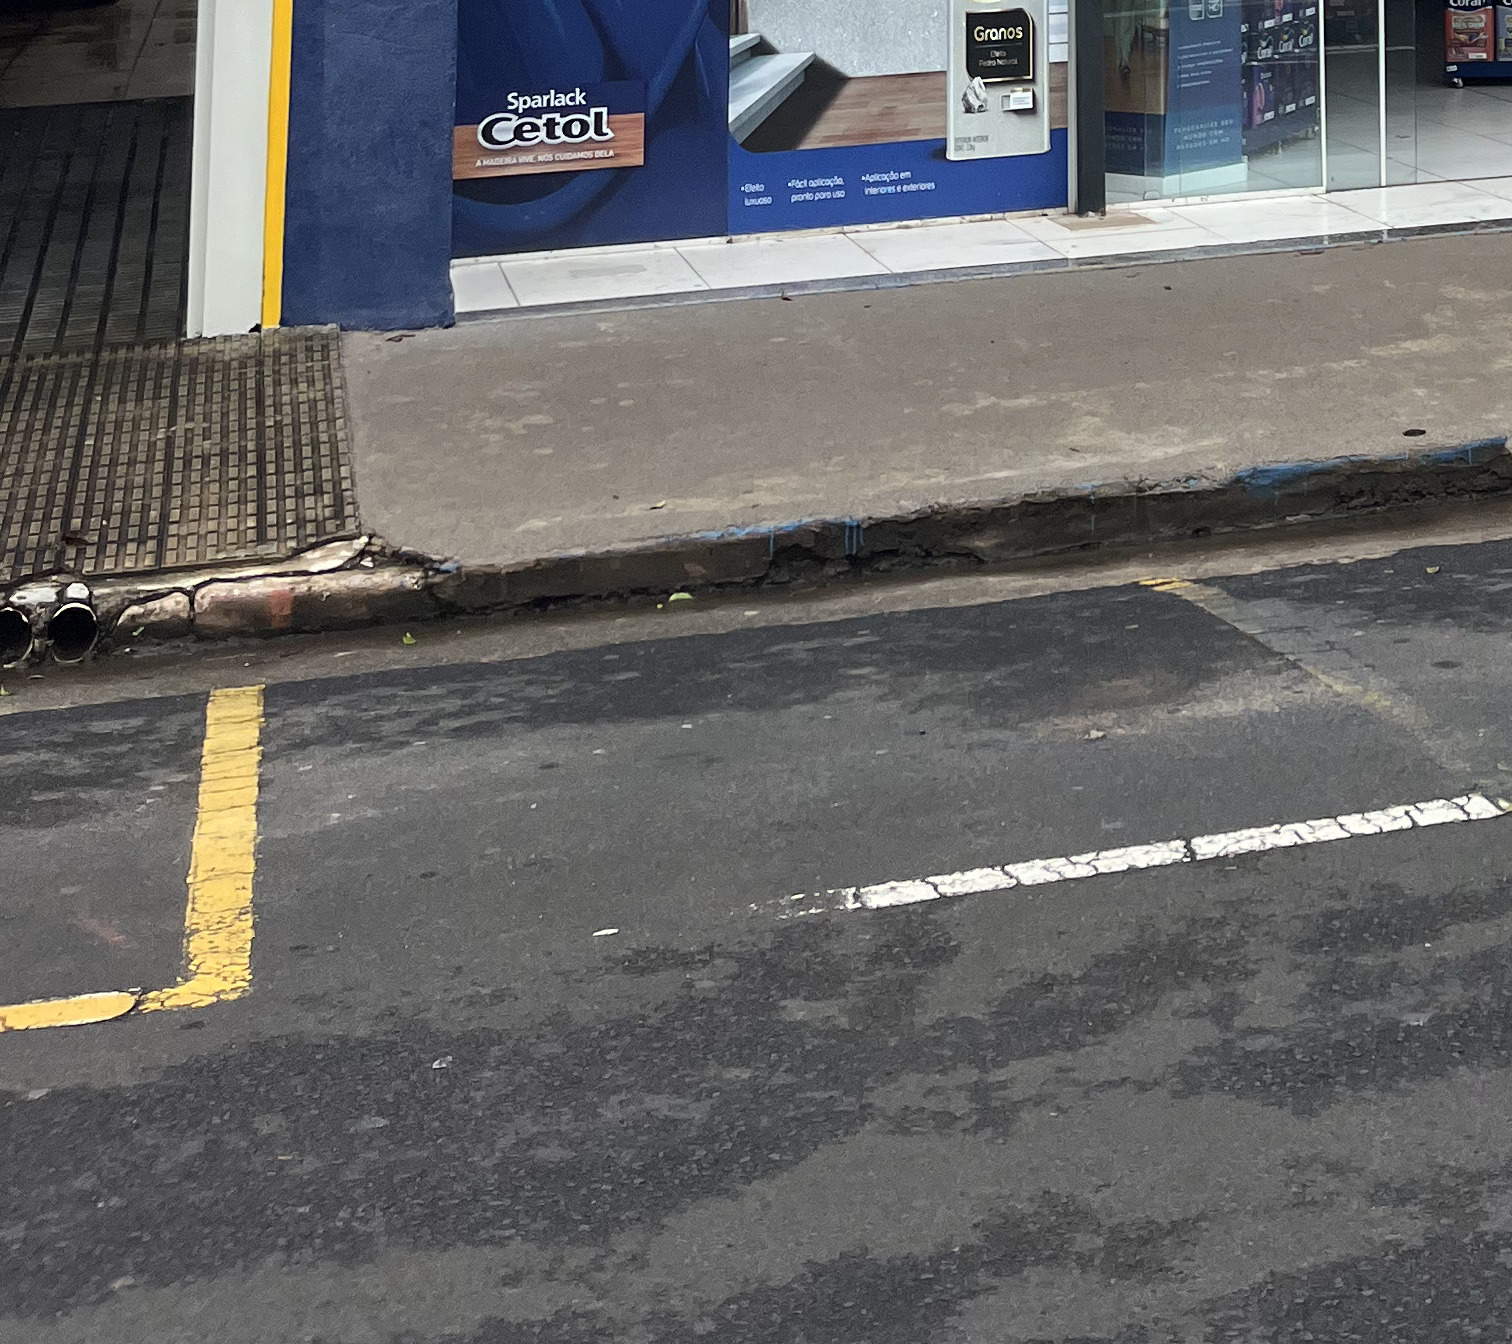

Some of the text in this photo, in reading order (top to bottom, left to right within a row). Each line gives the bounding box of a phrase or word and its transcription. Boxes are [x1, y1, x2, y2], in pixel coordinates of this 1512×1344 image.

[973, 25, 1024, 42] Granos
[507, 87, 587, 113] Sparlack
[478, 108, 614, 149] Cetol
[483, 155, 518, 166] MADEIRA
